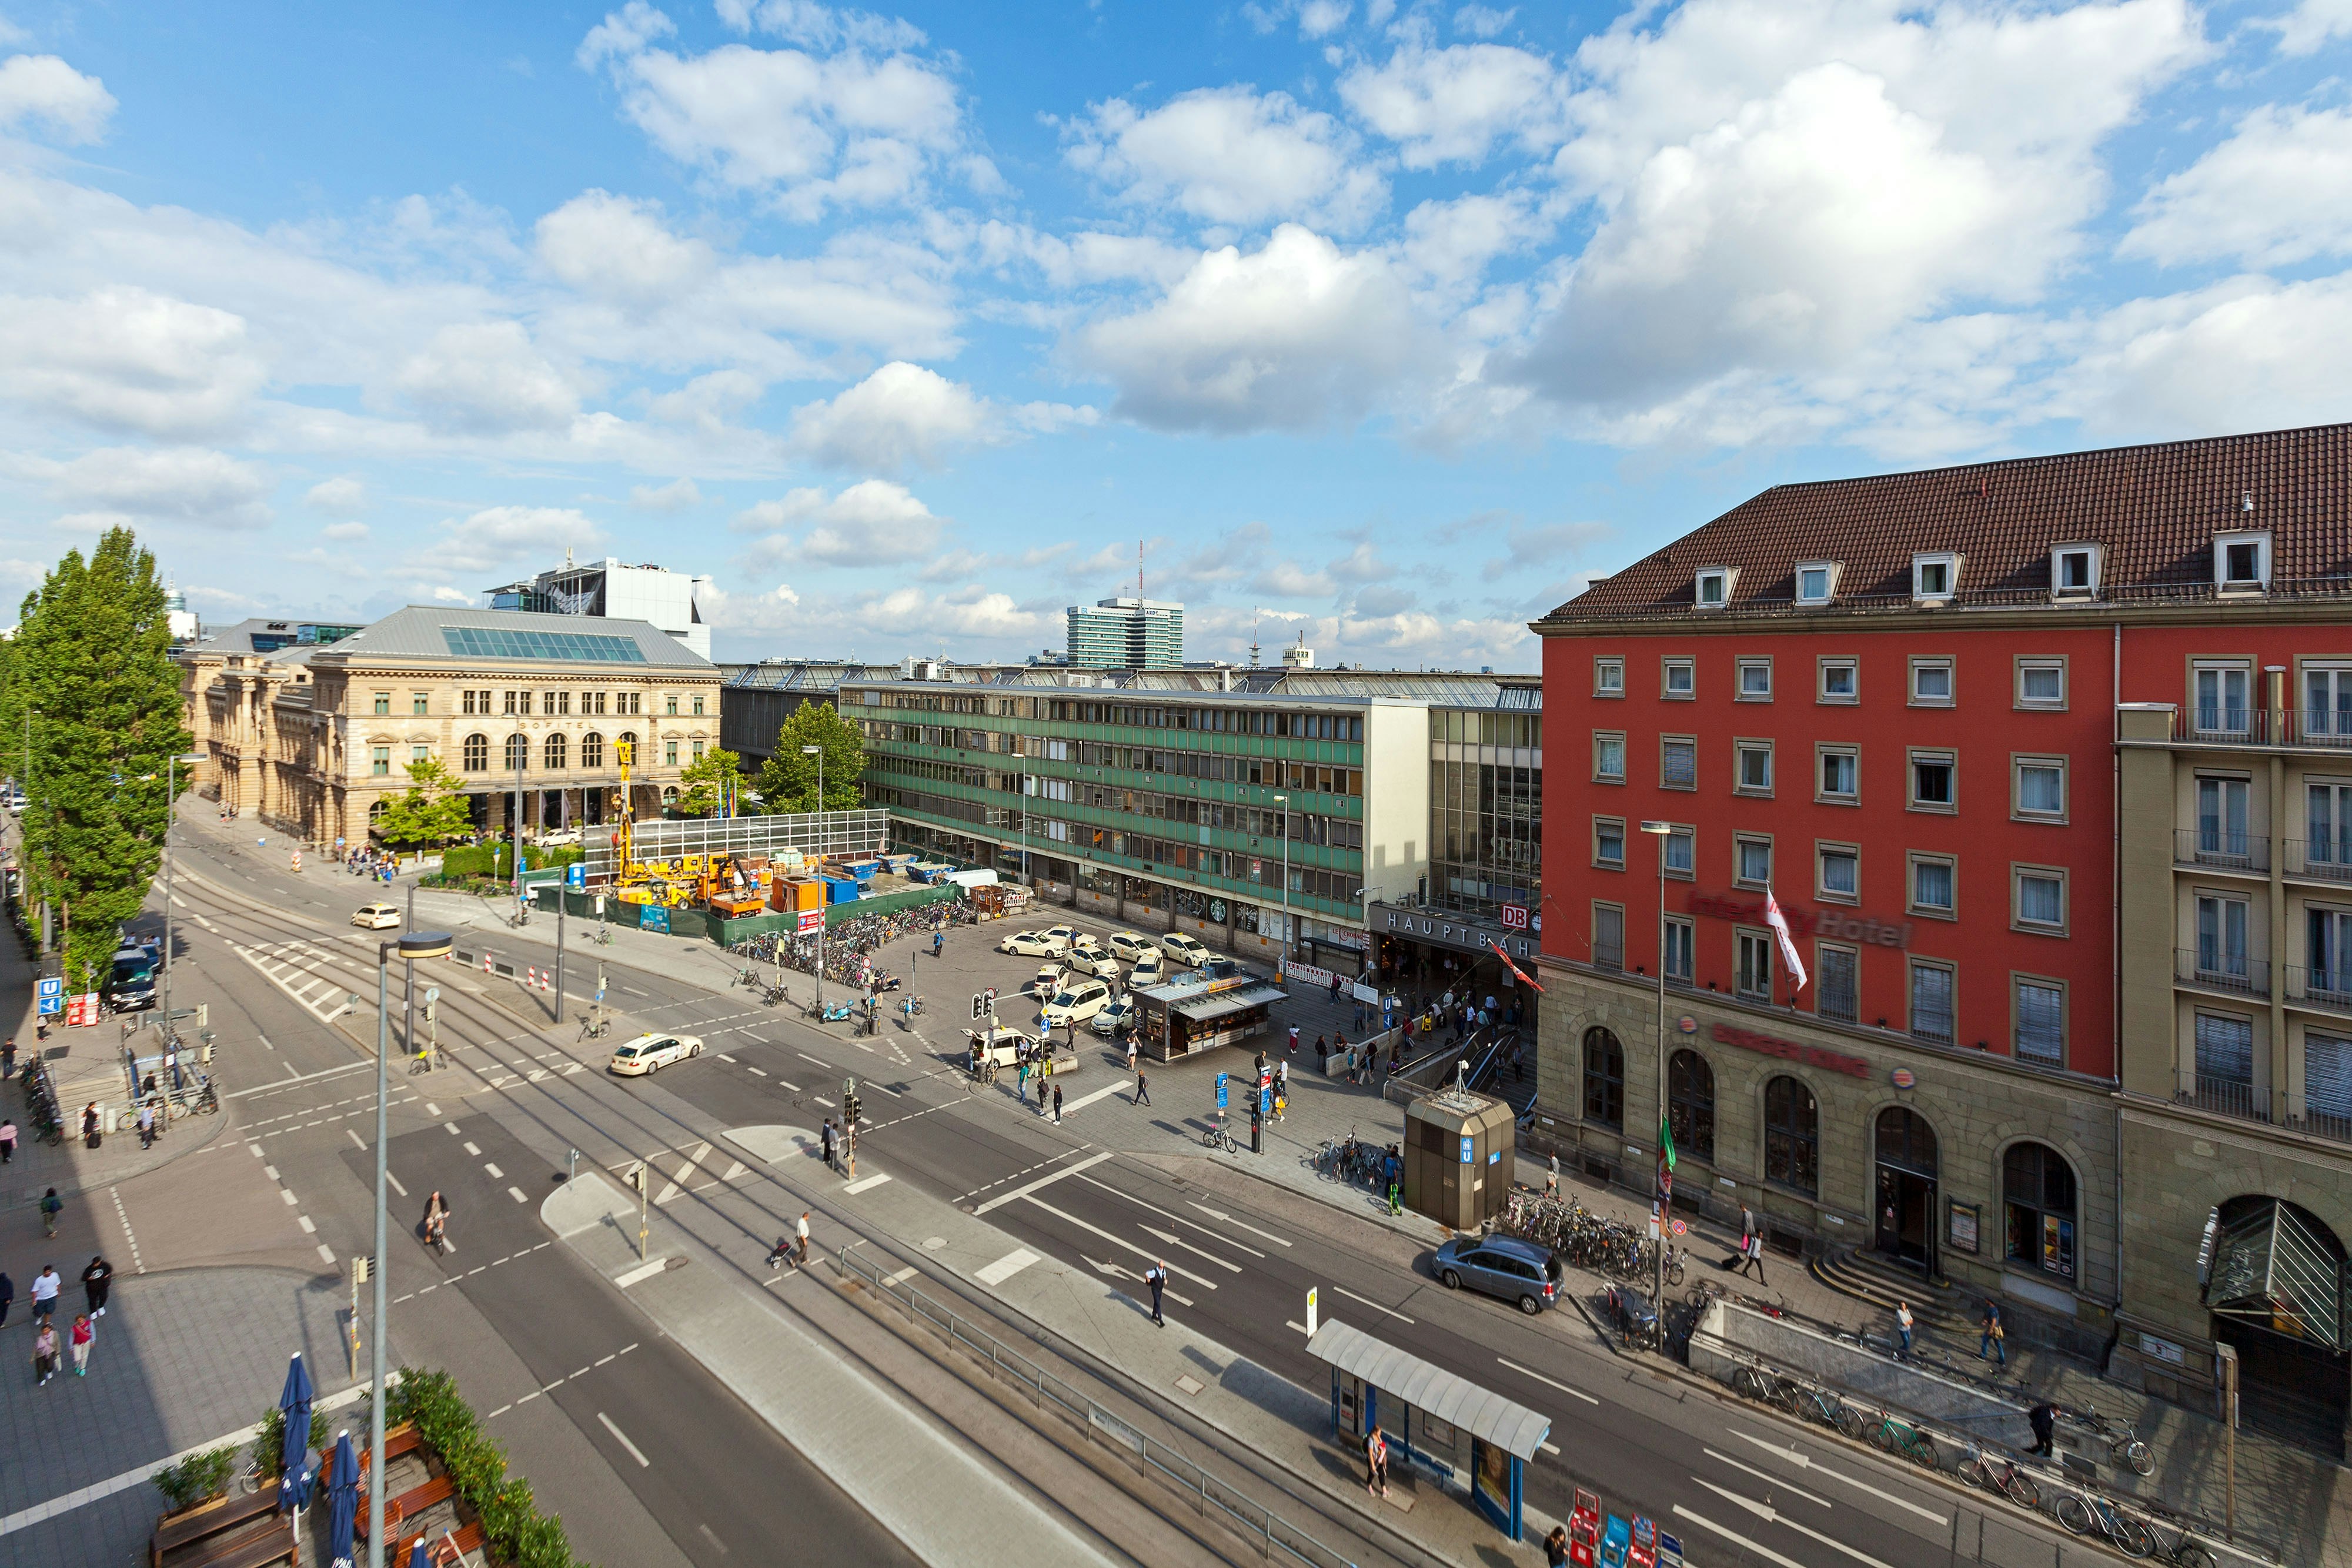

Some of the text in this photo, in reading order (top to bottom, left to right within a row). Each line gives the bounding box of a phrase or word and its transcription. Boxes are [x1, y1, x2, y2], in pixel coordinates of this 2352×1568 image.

[1505, 908, 1525, 927] DB
[43, 981, 58, 994] U
[1385, 999, 1391, 1010] U
[1463, 1152, 1471, 1162] U
